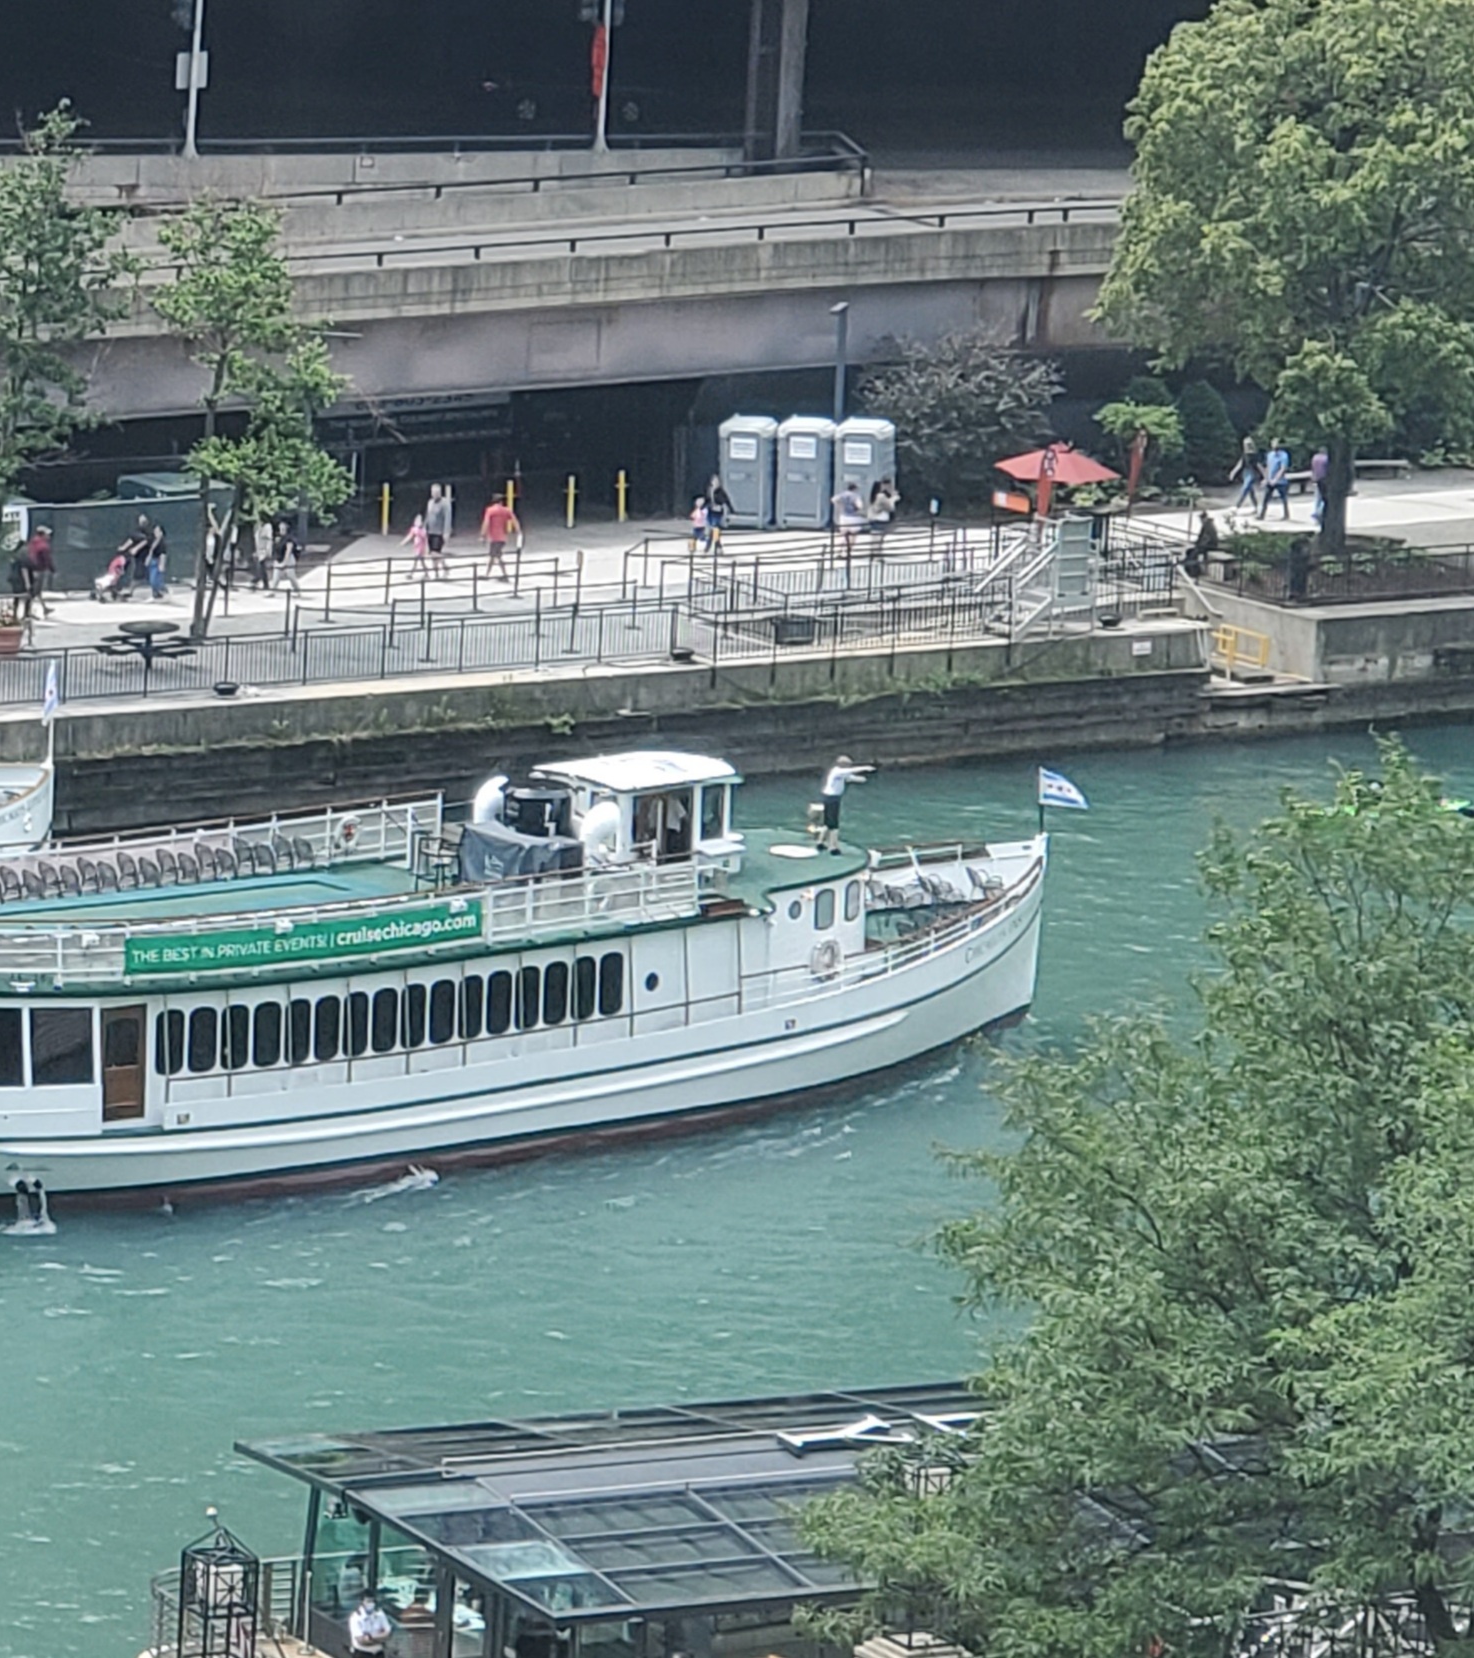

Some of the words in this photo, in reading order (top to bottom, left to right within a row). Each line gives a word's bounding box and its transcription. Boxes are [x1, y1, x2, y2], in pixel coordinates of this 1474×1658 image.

[132, 950, 159, 963] THE
[162, 946, 197, 962] BEST
[200, 946, 216, 959] IN
[216, 940, 271, 958] PRIVATE
[336, 914, 476, 945] cruisechicago.com
